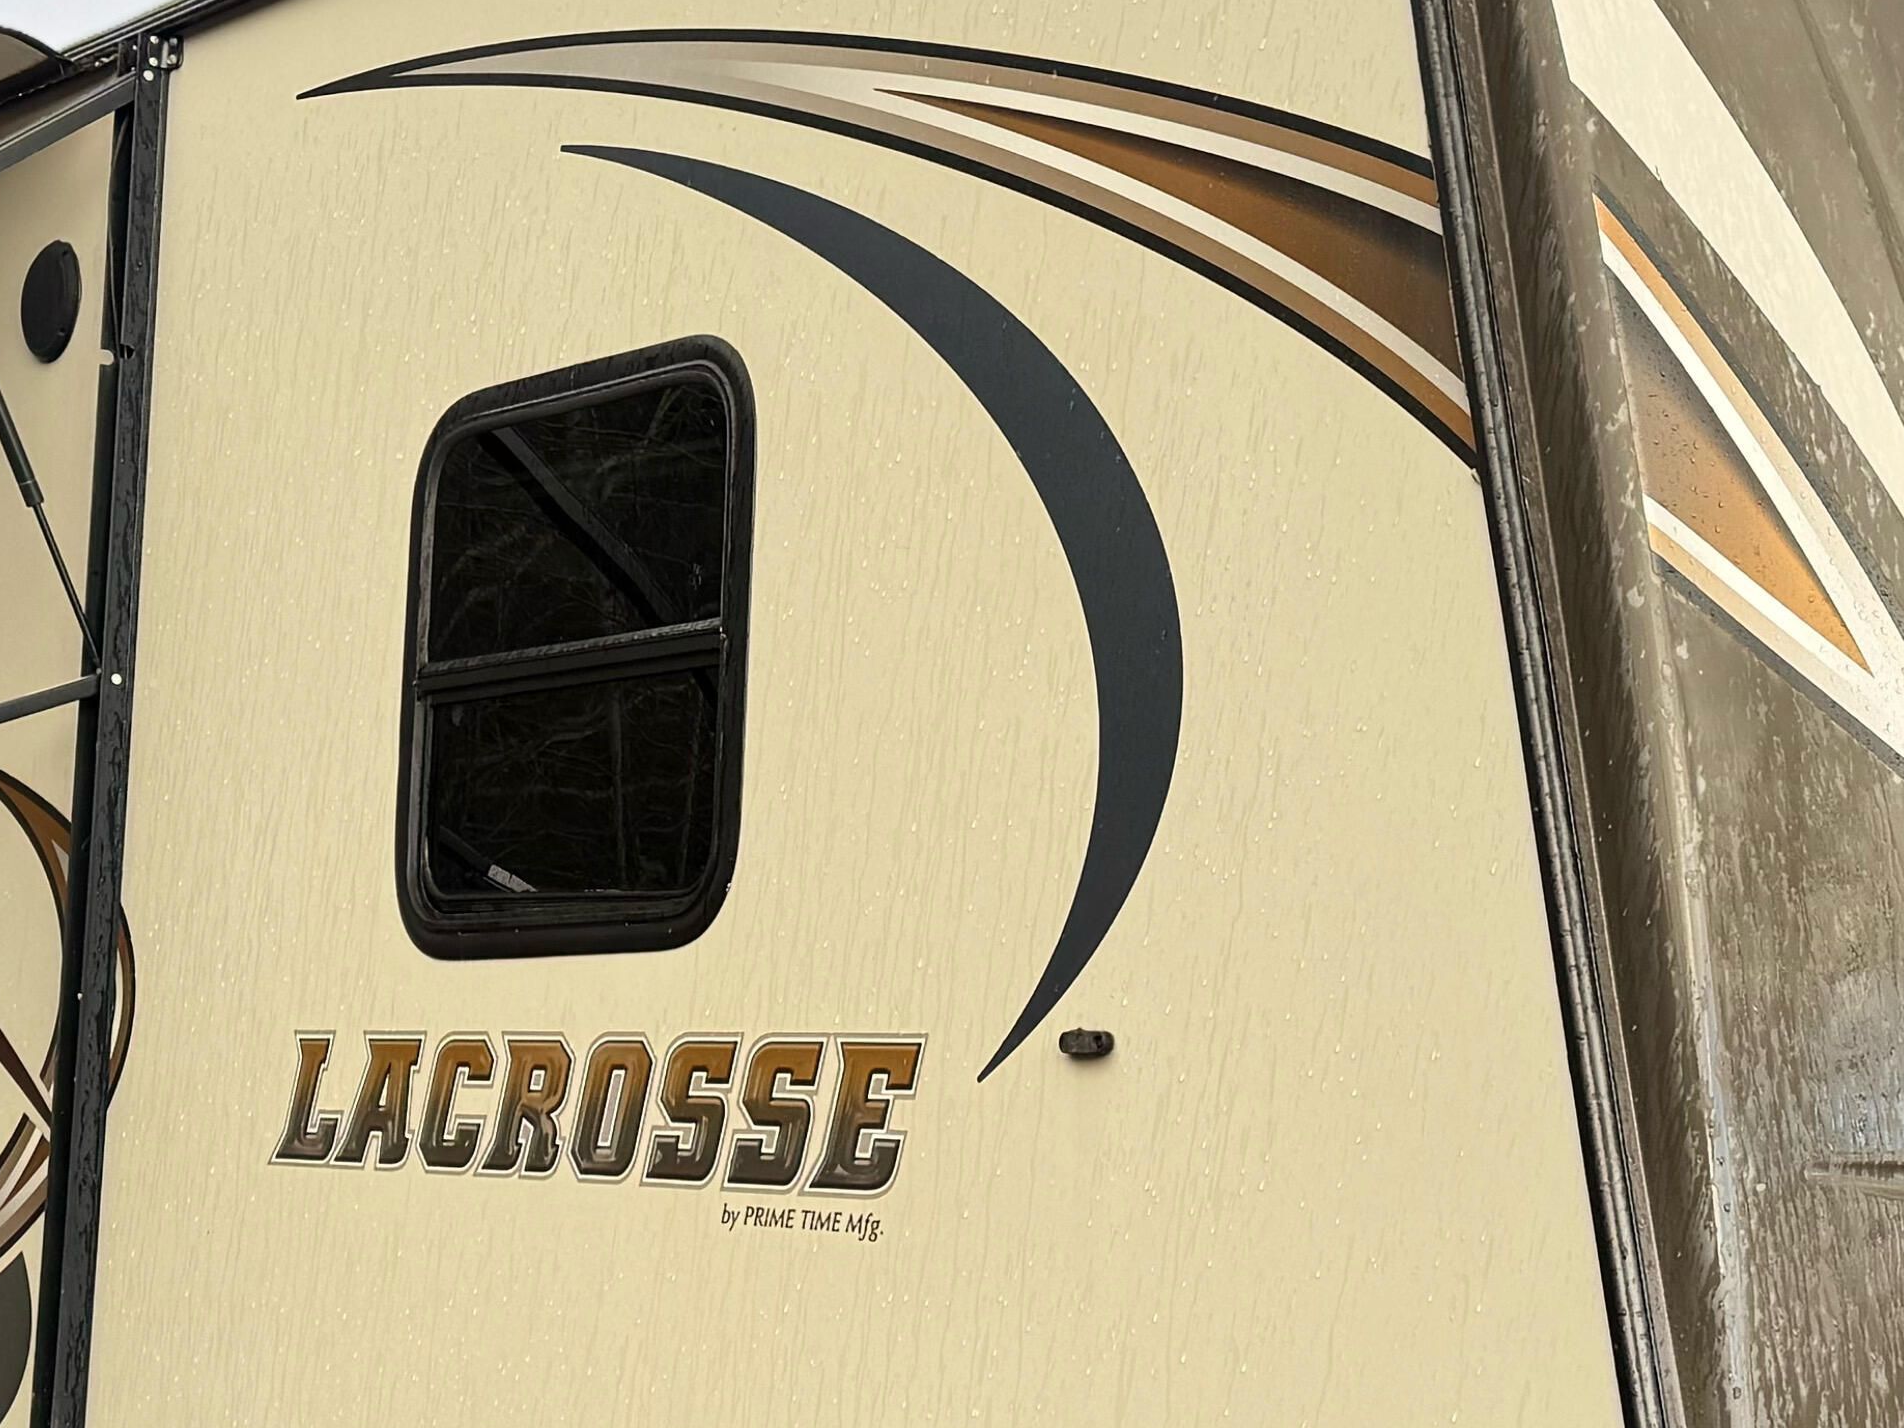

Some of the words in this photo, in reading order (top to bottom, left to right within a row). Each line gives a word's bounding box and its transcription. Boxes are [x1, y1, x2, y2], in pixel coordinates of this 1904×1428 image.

[267, 1029, 929, 1198] LACROSSE
[721, 1203, 740, 1231] by
[744, 1205, 796, 1230] PRIME
[801, 1209, 843, 1232] TIME
[845, 1212, 884, 1242] Mfg.
